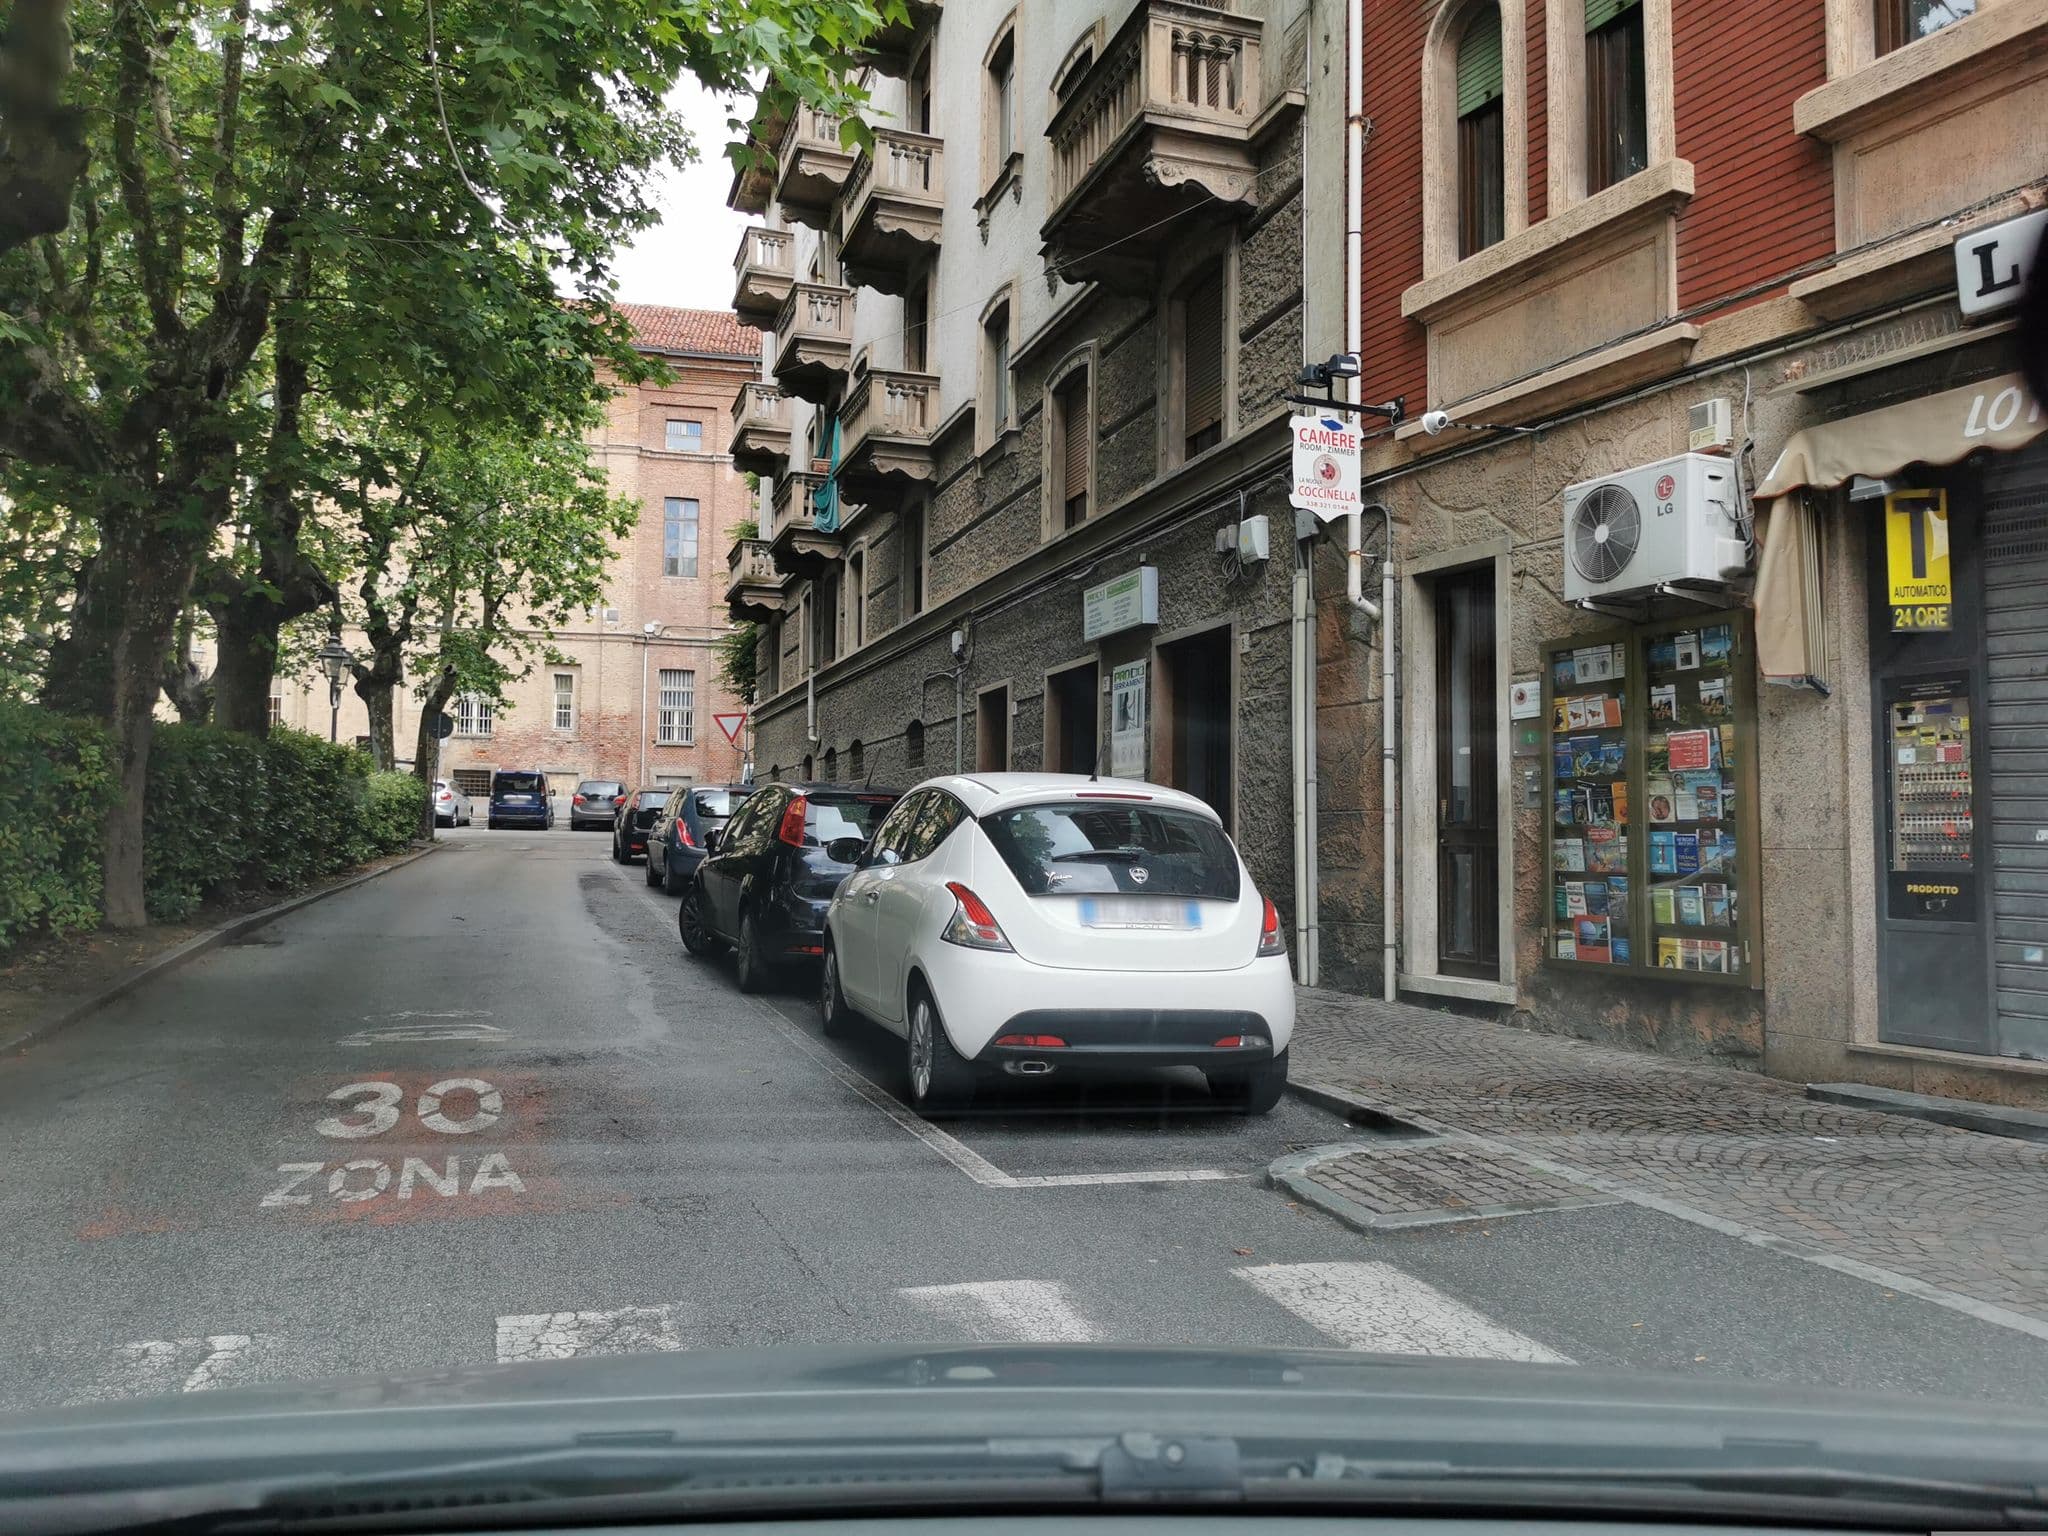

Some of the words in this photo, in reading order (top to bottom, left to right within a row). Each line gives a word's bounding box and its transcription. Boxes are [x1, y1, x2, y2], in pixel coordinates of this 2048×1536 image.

[1299, 427, 1356, 449] CAMERE
[1299, 442, 1322, 453] ROOM
[1327, 446, 1356, 457] ZIMMER
[1298, 485, 1357, 502] COCCINELLA
[1656, 502, 1674, 517] LG
[1893, 498, 1941, 579] T
[1894, 584, 1948, 598] AUTOMATICO
[1895, 607, 1913, 628] 24
[1915, 606, 1948, 627] ORE
[1906, 883, 1960, 895] PRODOTTO
[314, 1077, 503, 1138] 30
[258, 1151, 527, 1207] ZONA
